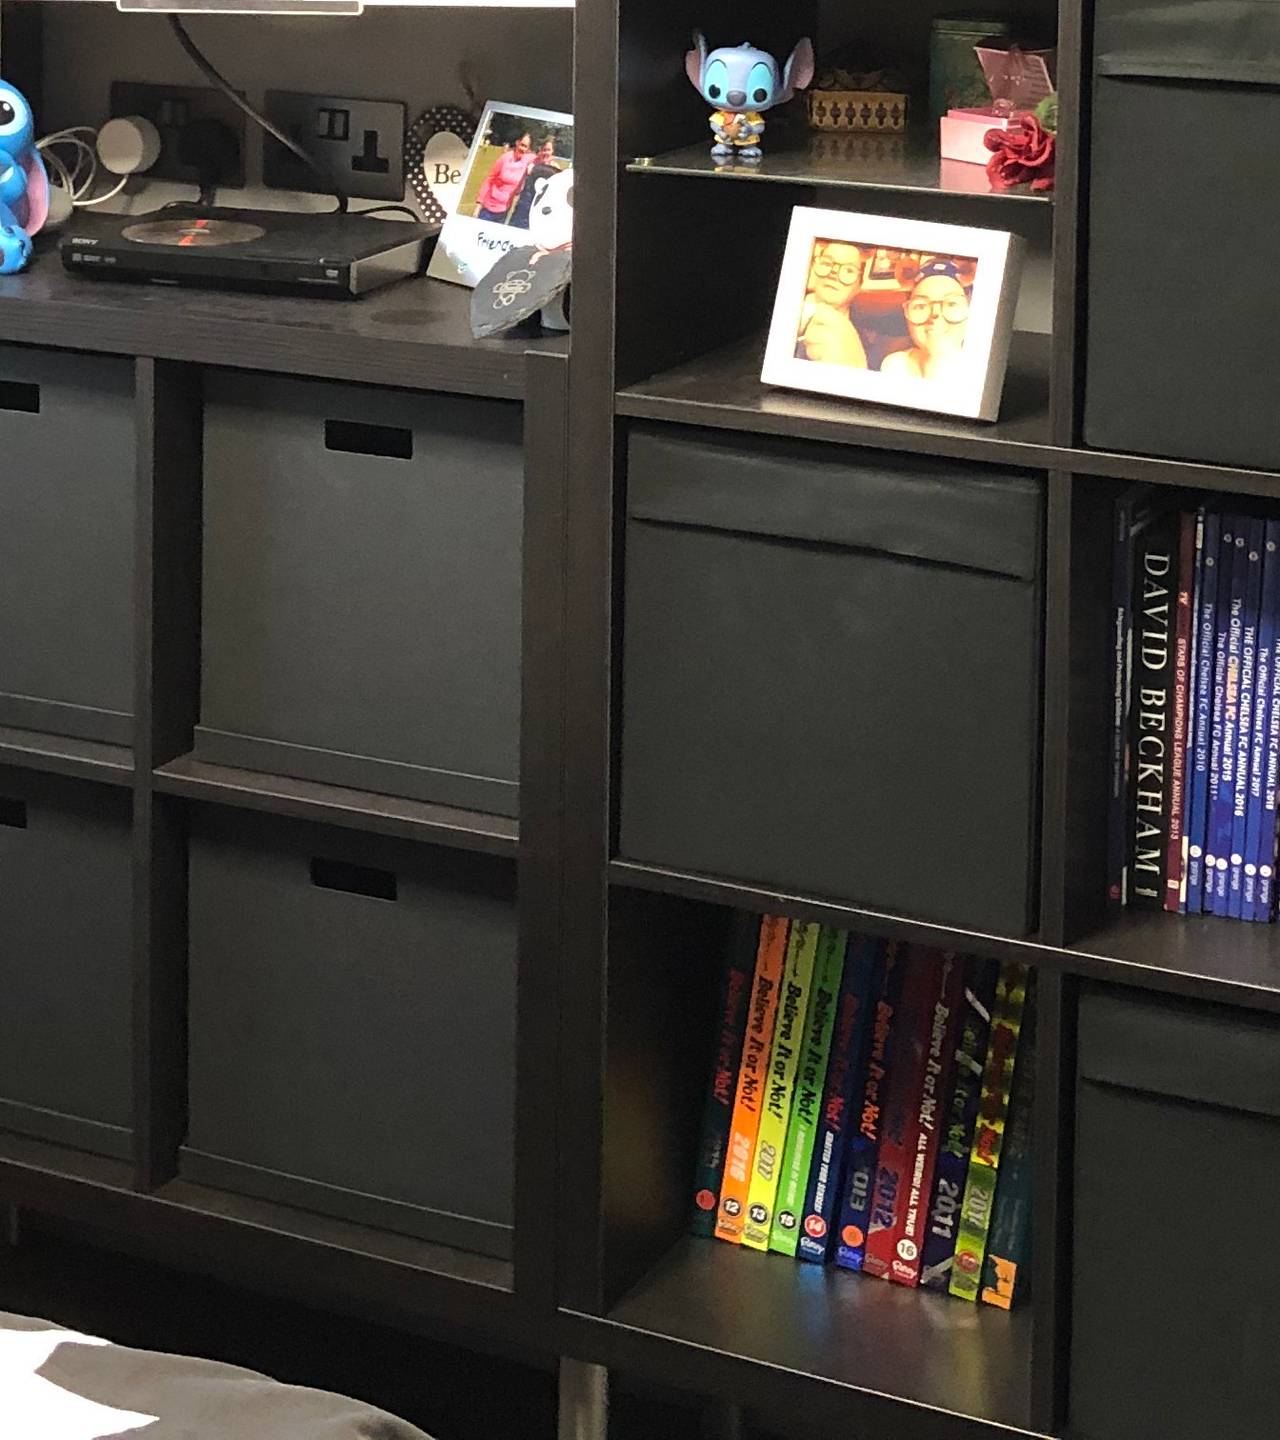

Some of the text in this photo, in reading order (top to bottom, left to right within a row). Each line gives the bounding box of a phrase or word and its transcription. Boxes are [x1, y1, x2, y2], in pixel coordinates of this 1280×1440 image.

[433, 163, 462, 185] Be
[1259, 648, 1269, 663] The
[1195, 603, 1213, 771] The Official Chelsea FC Annual 2010
[1221, 598, 1242, 782] The Official CHELSEA FC Annual 2015
[1257, 664, 1269, 696] Official
[1135, 552, 1170, 876] DAVID BECKHAM
[1209, 632, 1227, 771] The Official Chelsea FC Annual
[1255, 698, 1267, 731] Chelsea
[1233, 626, 1256, 817] THE OFFICIAL CHELSEA FC ANNUAL 2016
[1169, 638, 1187, 840] STARS OF CHAMPIONS LEAGUE ANNUAL 2013
[1254, 732, 1265, 744] FC
[1268, 738, 1279, 750] FC
[1251, 746, 1264, 776] Annual
[1266, 752, 1279, 788] ANNUAL
[751, 975, 774, 1034] Believe
[780, 981, 802, 1040] Believe
[747, 1036, 764, 1052] It
[929, 1001, 950, 1059] Believe
[745, 1053, 760, 1072] or
[776, 1043, 793, 1059] It
[926, 1059, 942, 1075] It
[773, 1061, 790, 1080] or
[802, 1066, 818, 1085] or
[923, 1074, 936, 1094] or
[741, 1073, 760, 1112] Not!
[767, 1080, 787, 1119] Not!
[796, 1085, 817, 1126] Not!
[858, 1101, 880, 1141] Not!
[918, 1093, 935, 1130] Not!
[917, 1133, 928, 1151] ALL
[757, 1139, 776, 1181] 2017
[724, 1200, 740, 1214] 12
[909, 1188, 921, 1206] ALL
[930, 1177, 961, 1240] 2011
[751, 1207, 767, 1222] 13
[779, 1212, 795, 1227] 15
[899, 1243, 915, 1258] 16
